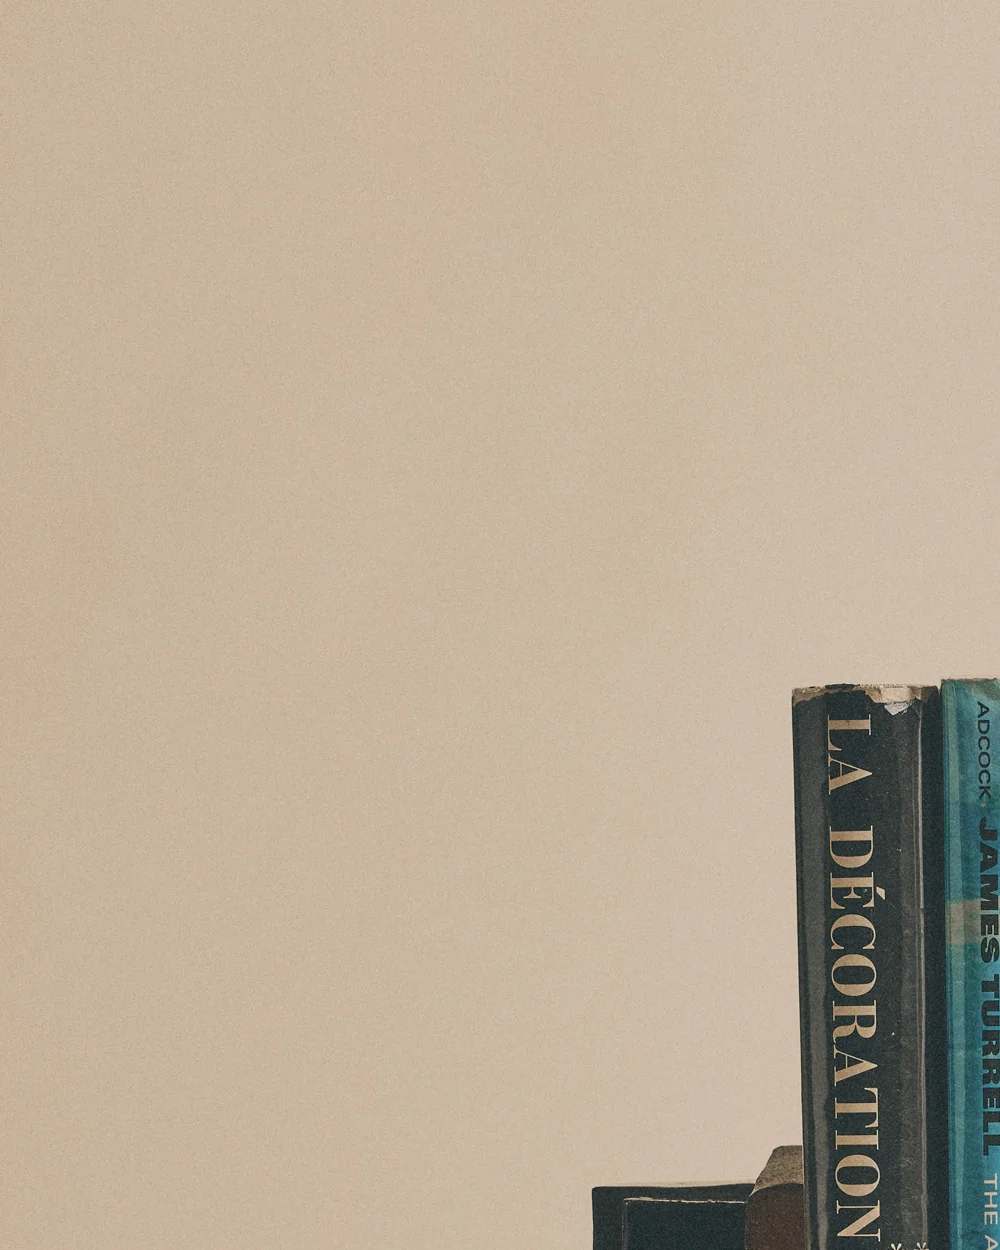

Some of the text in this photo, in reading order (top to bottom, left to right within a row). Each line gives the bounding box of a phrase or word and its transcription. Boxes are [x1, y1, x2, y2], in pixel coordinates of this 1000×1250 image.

[977, 701, 992, 800] ADCOCK
[979, 816, 1000, 964] JAMES
[827, 714, 886, 1241] LA DÉCORATION
[983, 1173, 998, 1225] THE
